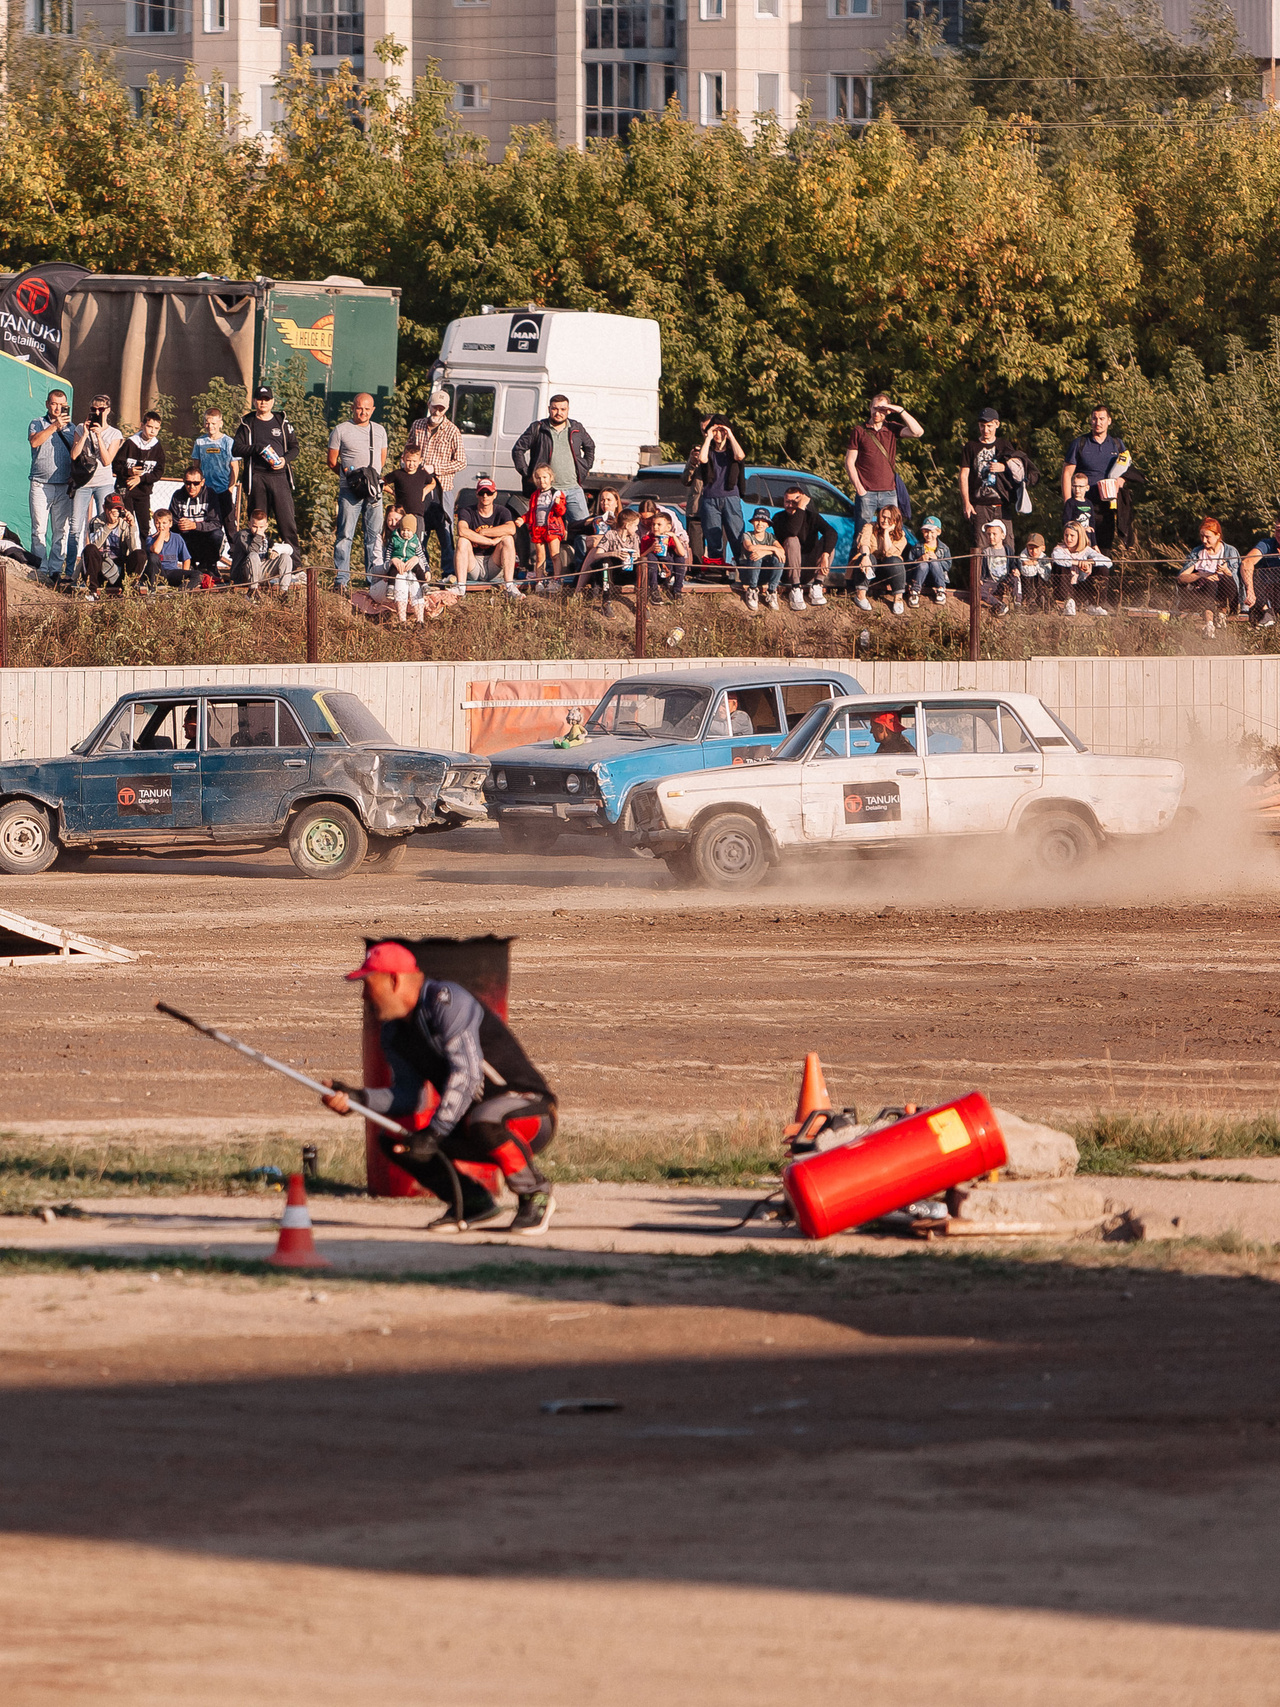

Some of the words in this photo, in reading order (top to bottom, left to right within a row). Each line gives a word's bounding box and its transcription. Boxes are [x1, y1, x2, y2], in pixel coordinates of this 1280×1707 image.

[4, 331, 46, 352] Detailing
[299, 331, 319, 346] HELGE
[138, 788, 172, 798] TANUKI
[865, 794, 900, 805] TANUKI
